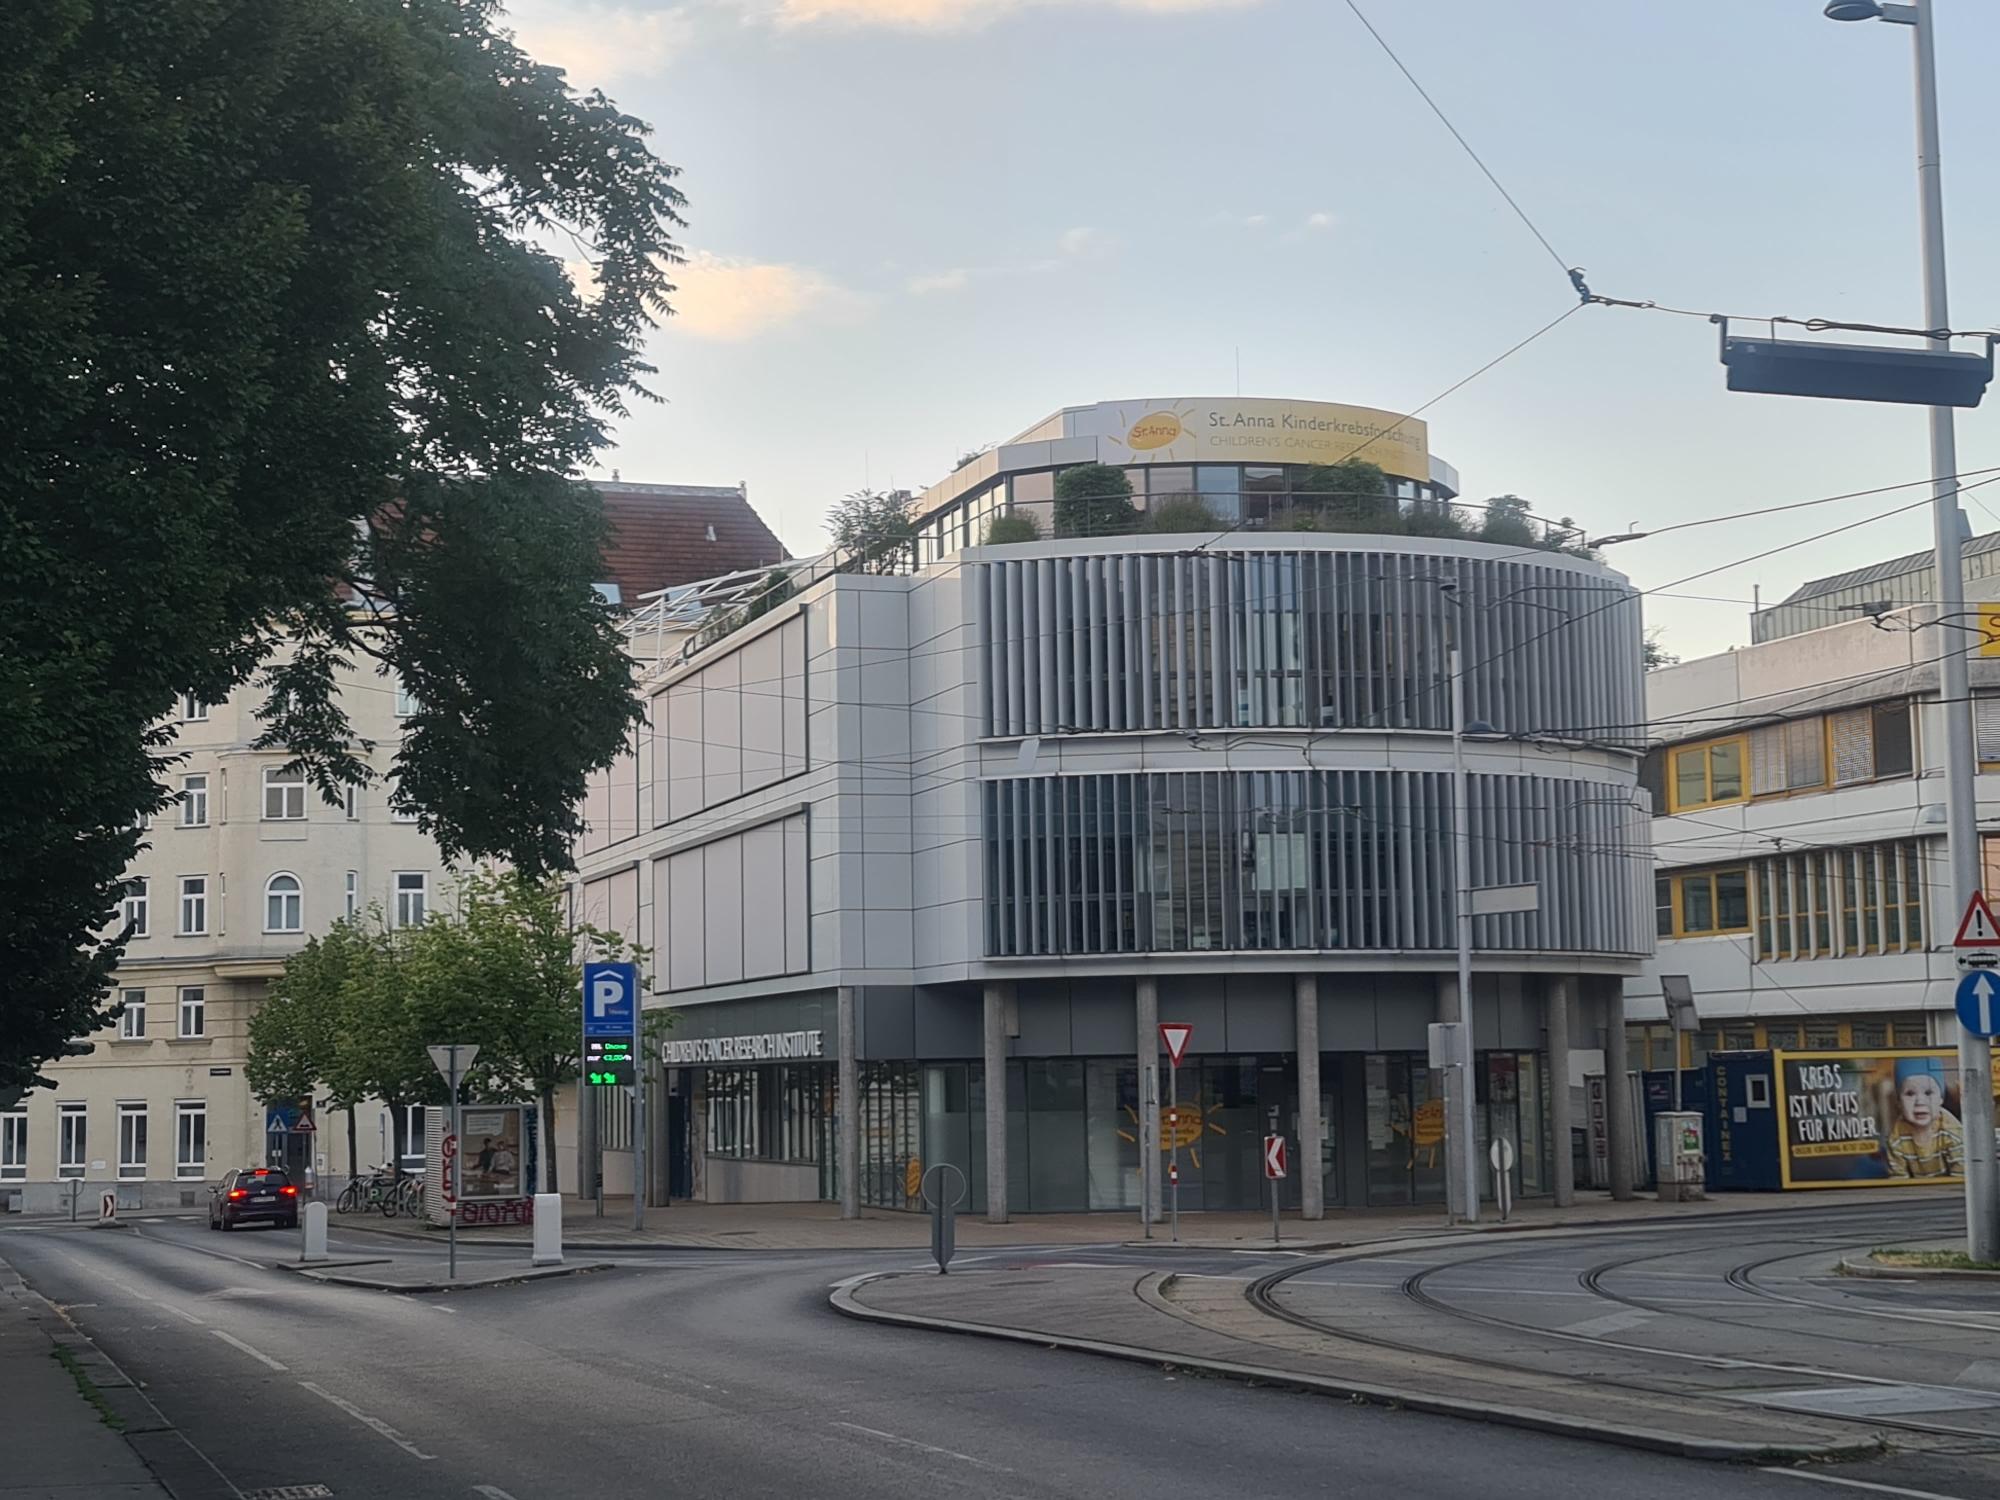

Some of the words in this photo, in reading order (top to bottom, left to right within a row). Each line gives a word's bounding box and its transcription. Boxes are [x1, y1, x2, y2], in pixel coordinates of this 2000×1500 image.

[1232, 411, 1276, 429] Anna
[1284, 437, 1331, 450] CANCER
[593, 981, 624, 1017] P
[702, 1036, 734, 1061] CANCER
[734, 1033, 775, 1060] RESEARCH
[776, 1029, 822, 1058] INSTITUTE
[1799, 1063, 1842, 1091] KREBS
[1716, 1065, 1733, 1162] CONTAINEX
[1789, 1094, 1808, 1118] IST
[1811, 1091, 1859, 1116] NICHTS
[1798, 1118, 1825, 1142] FÜR
